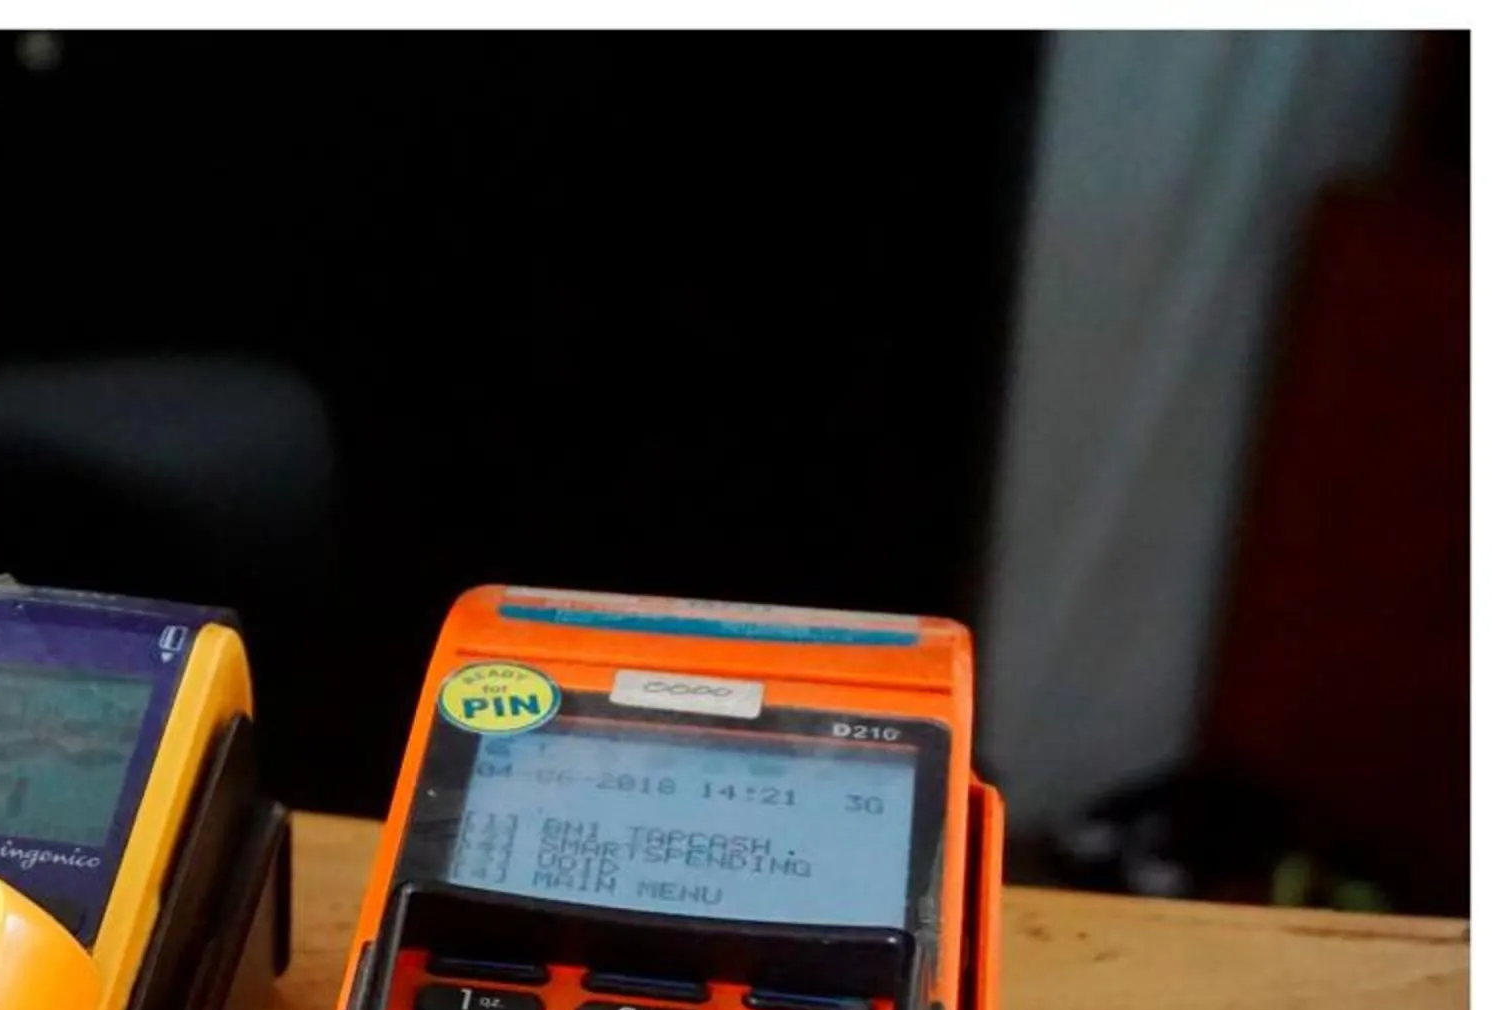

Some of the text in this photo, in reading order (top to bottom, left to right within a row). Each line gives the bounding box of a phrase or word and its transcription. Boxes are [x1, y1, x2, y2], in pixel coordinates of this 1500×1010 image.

[463, 695, 542, 719] PIN
[832, 722, 902, 741] D210
[701, 782, 796, 806] 14:21
[844, 794, 885, 815] 3G
[543, 817, 600, 838] BNI
[627, 826, 772, 852] TAPCASH
[531, 870, 617, 896] MAIN
[636, 880, 723, 905] MENU
[460, 988, 473, 1010] 1
